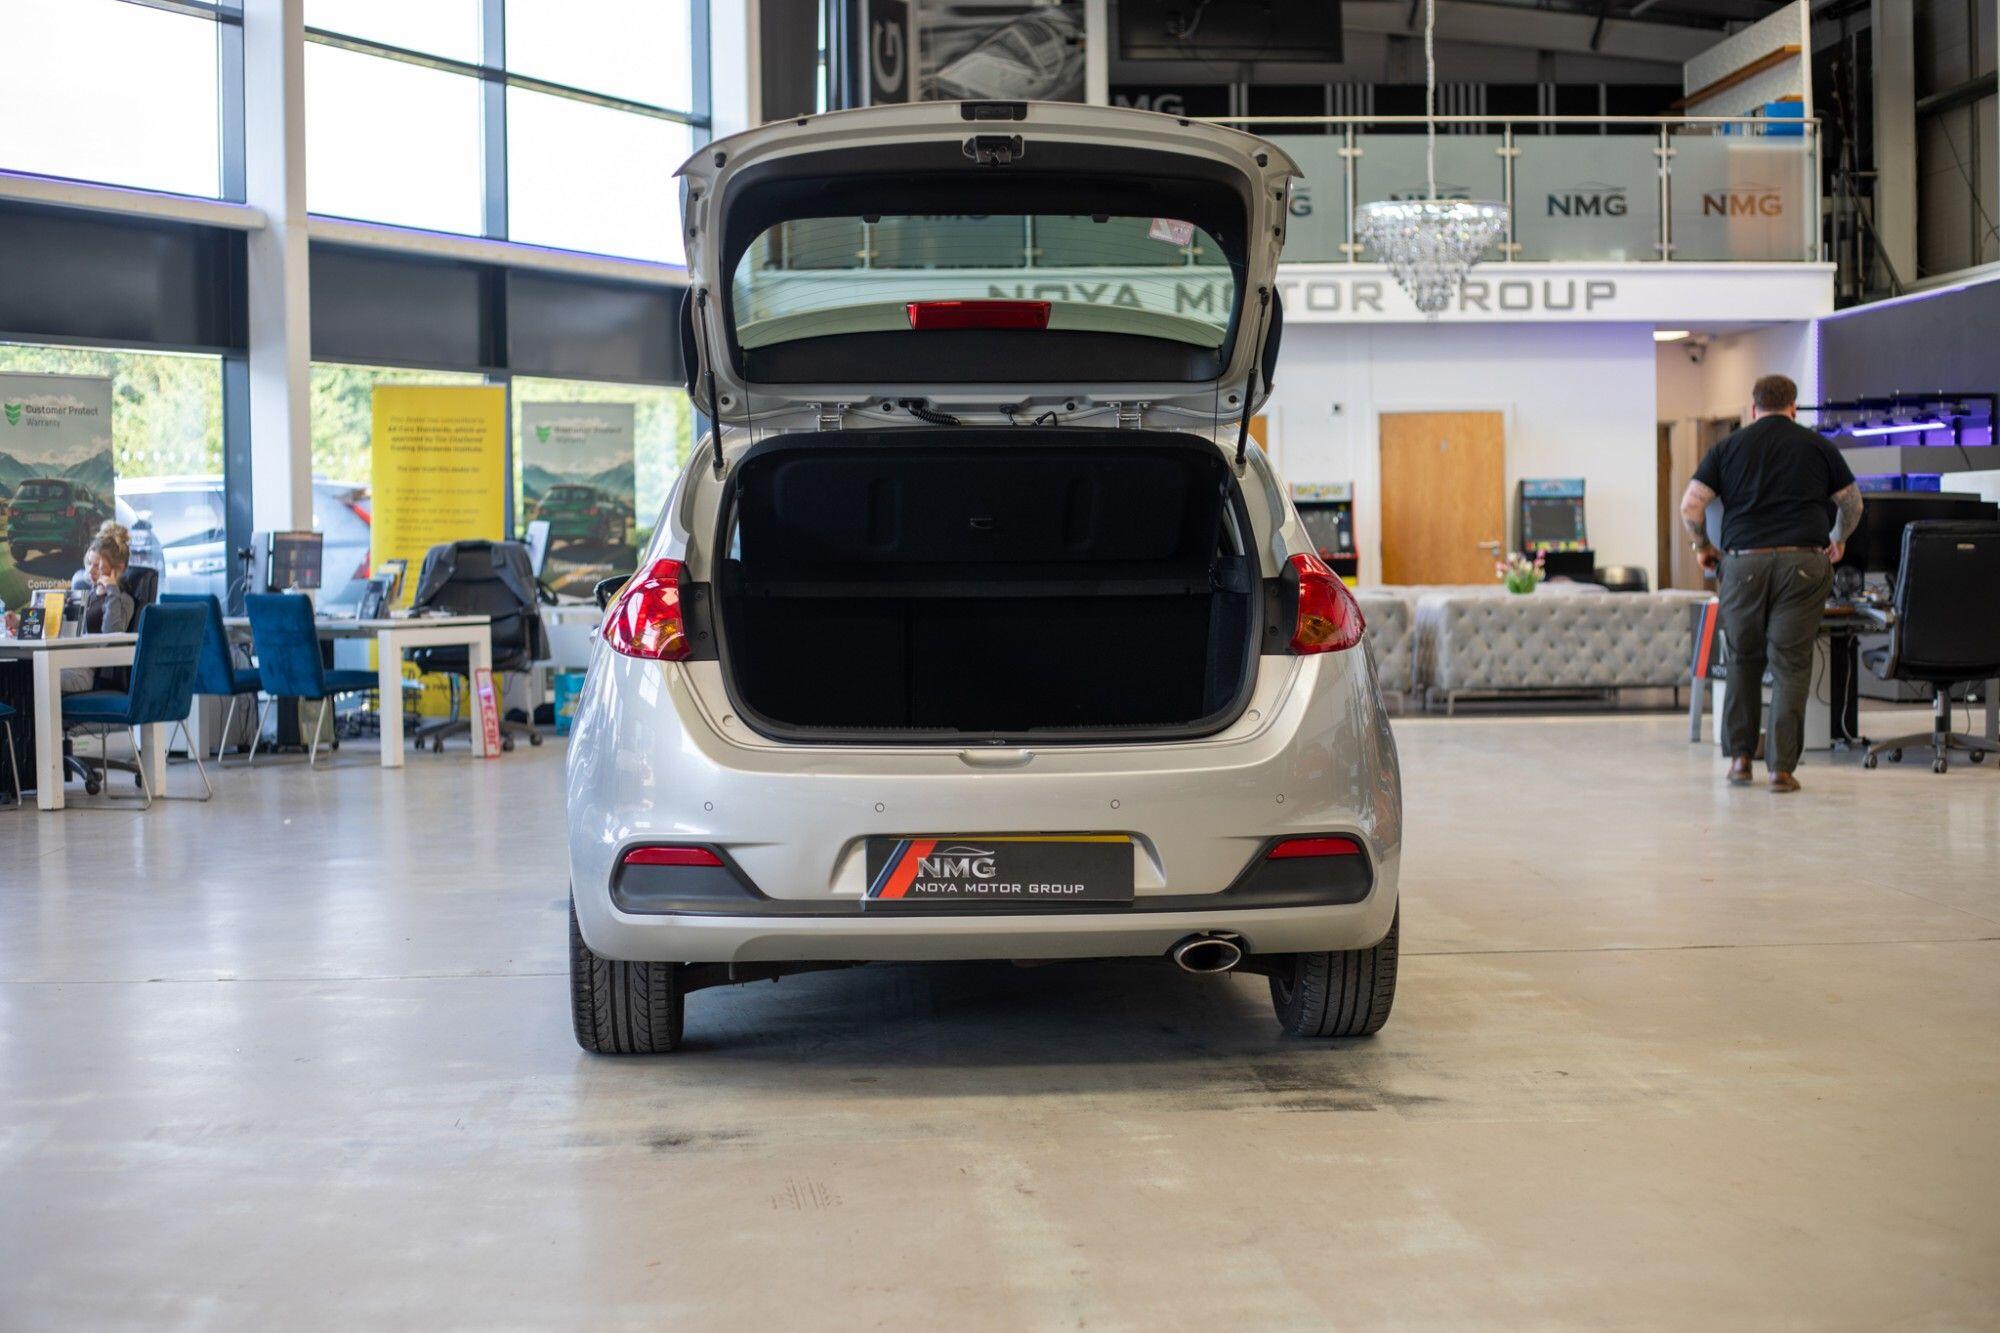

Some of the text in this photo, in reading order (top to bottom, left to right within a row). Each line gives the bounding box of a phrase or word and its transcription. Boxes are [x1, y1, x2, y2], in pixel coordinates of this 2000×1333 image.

[1547, 193, 1628, 217] NMG
[1702, 193, 1782, 217] NMG
[988, 283, 1142, 308] NOYA
[1456, 279, 1617, 312] ROUP
[25, 404, 99, 416] Customer Protect
[26, 417, 61, 428] Warranty
[916, 857, 996, 878] NMG
[915, 882, 1085, 894] NOYA MOTOR GROUP
